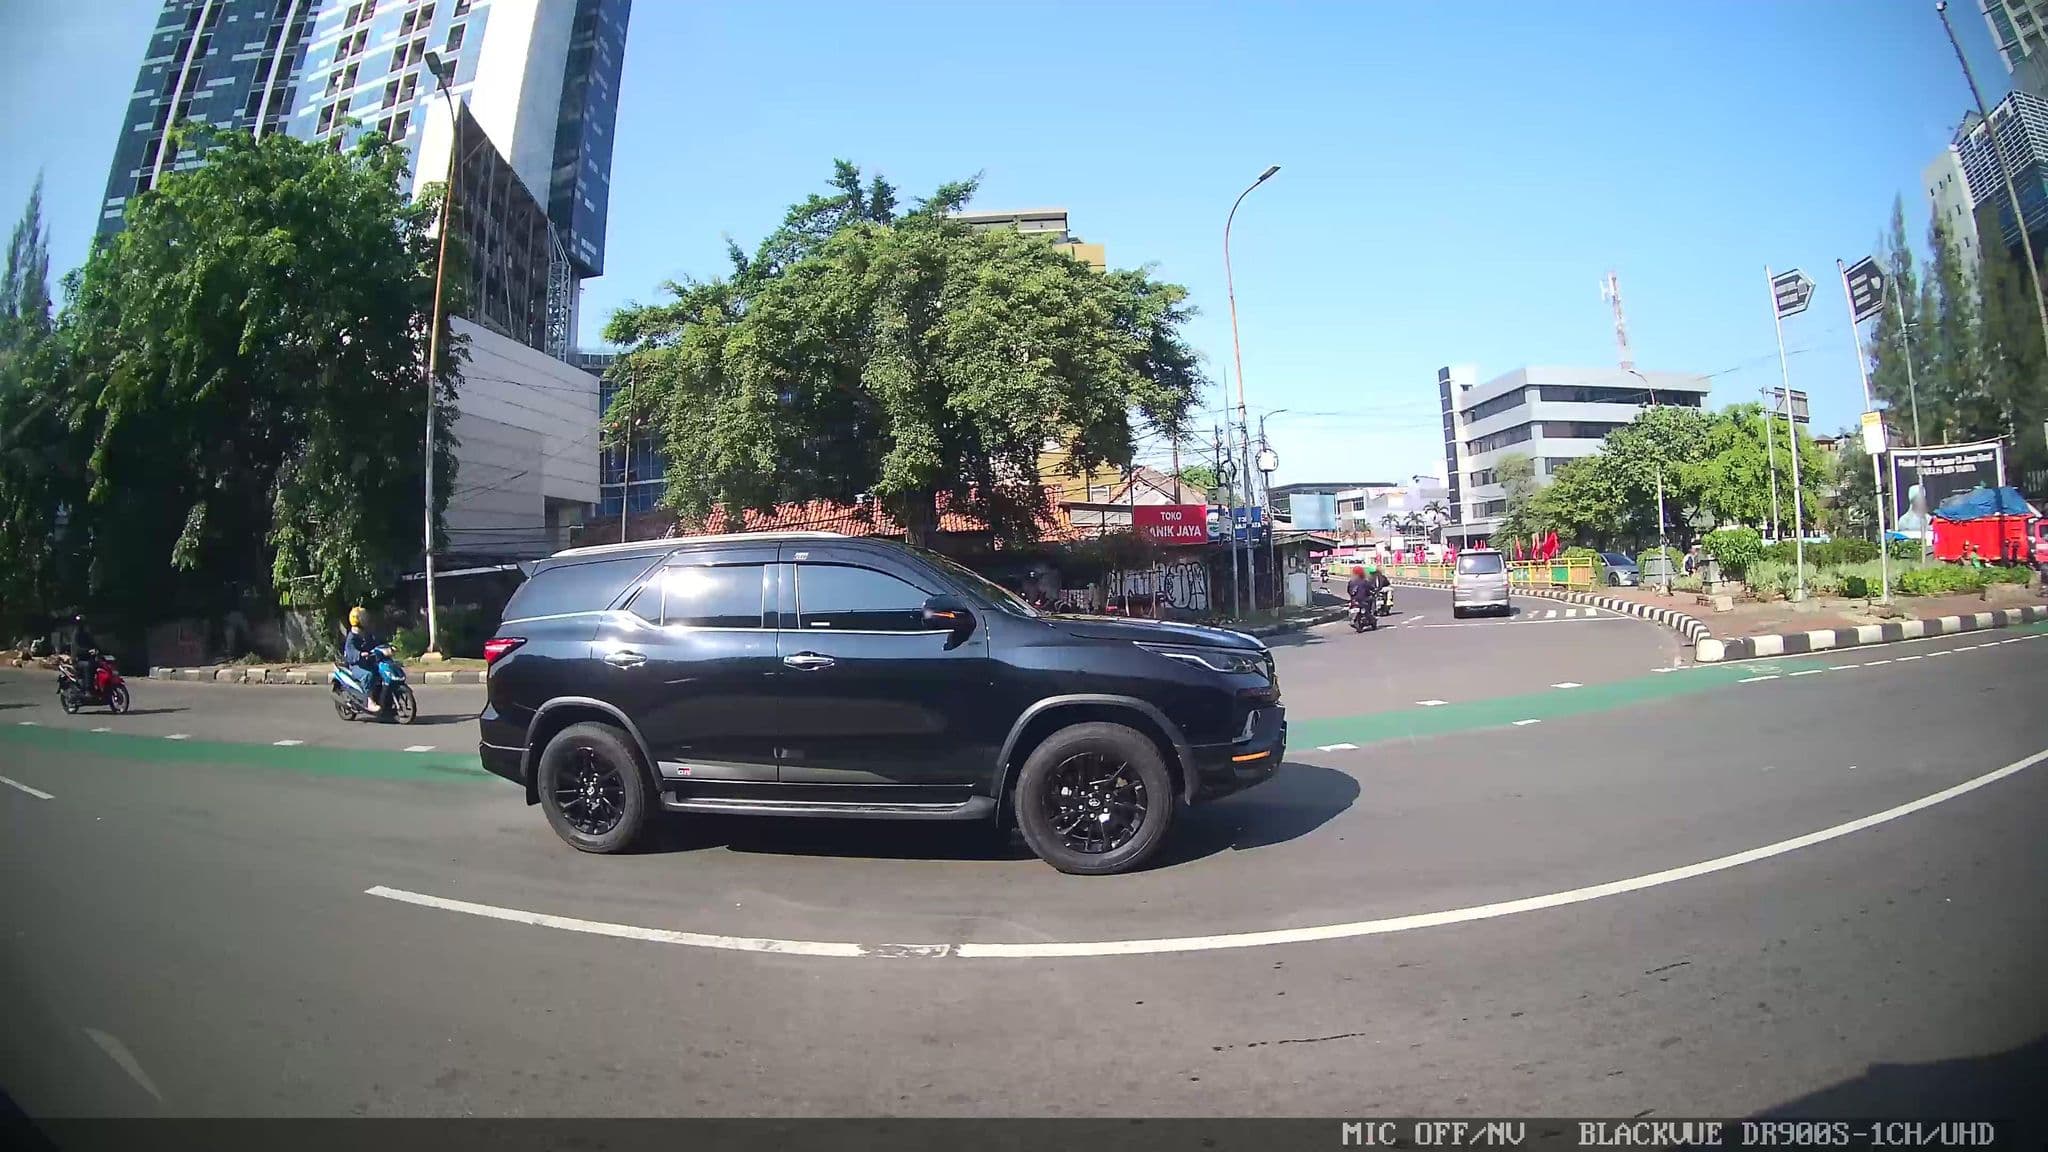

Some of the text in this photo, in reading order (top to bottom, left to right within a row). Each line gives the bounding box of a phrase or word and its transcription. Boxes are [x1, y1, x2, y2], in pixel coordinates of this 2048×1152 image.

[1160, 511, 1182, 521] TOKO
[1148, 525, 1202, 537] ANIK JAYA
